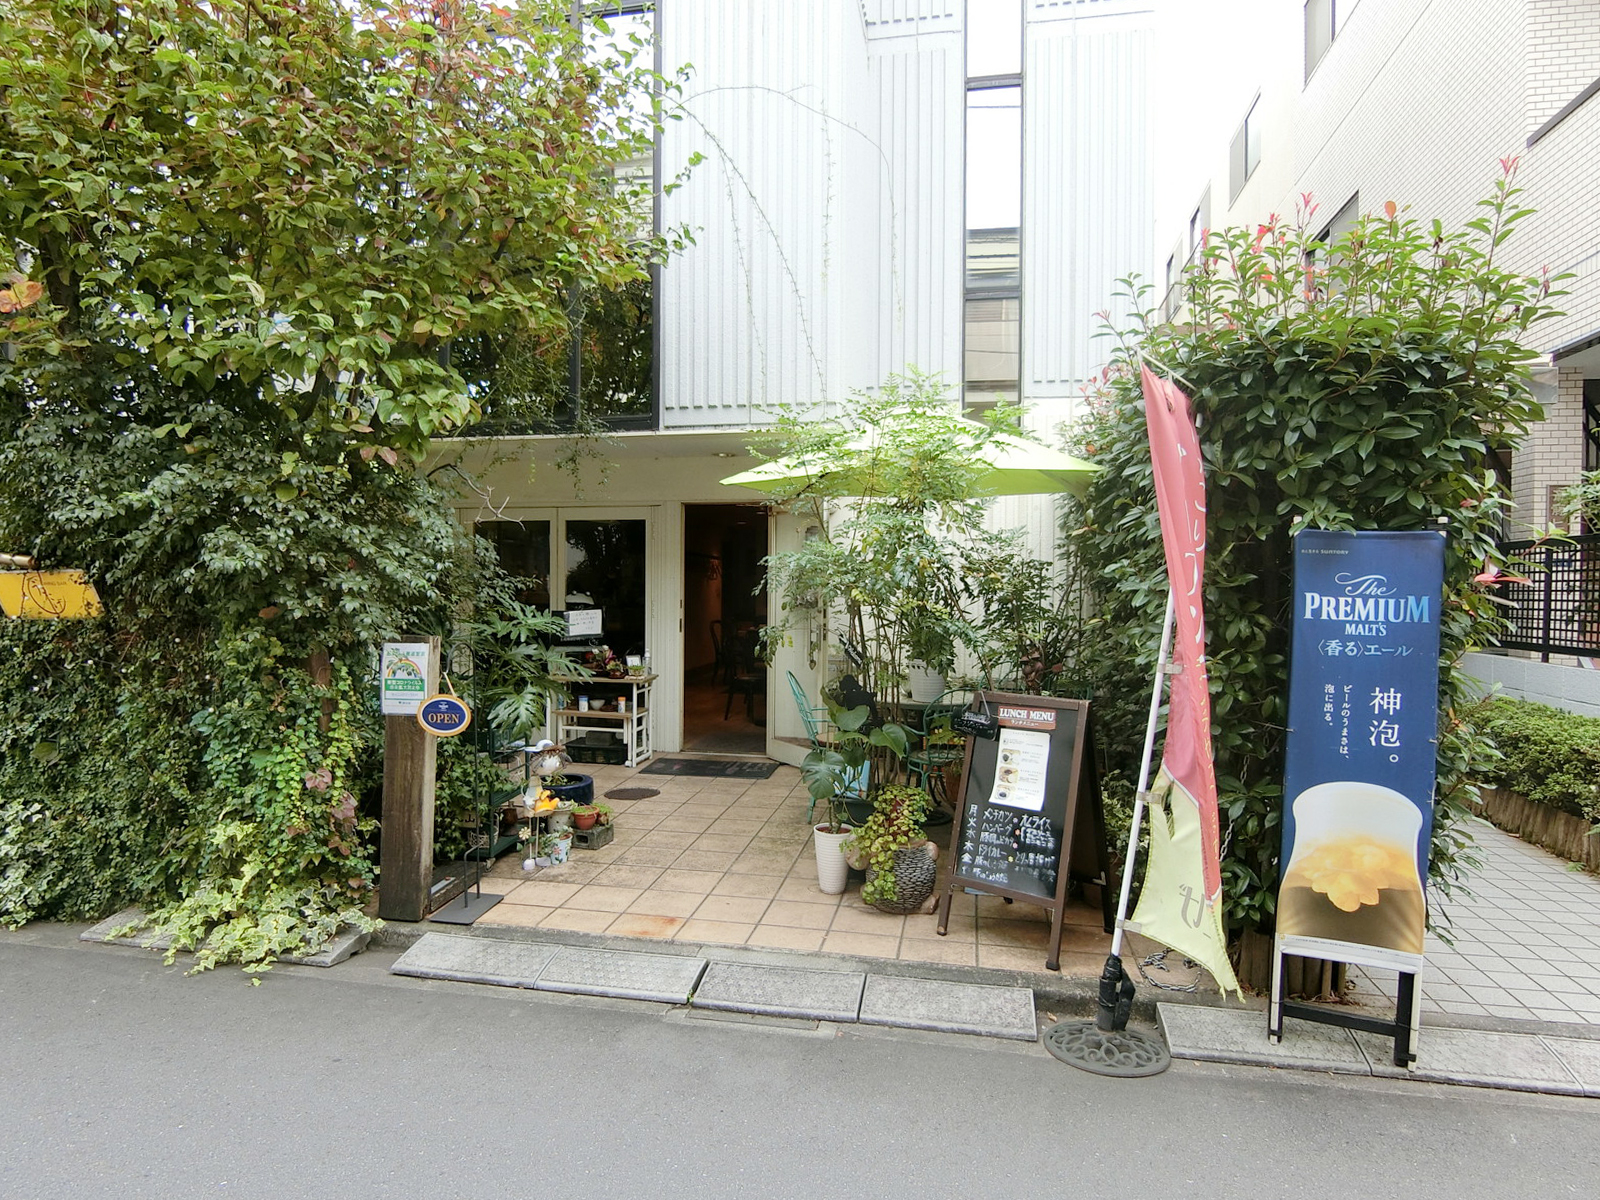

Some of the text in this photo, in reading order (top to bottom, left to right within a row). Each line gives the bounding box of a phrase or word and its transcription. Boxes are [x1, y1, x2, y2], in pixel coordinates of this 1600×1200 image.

[1334, 572, 1397, 596] The
[1303, 592, 1431, 624] PREMIUM
[1345, 622, 1387, 637] MALT'S
[428, 712, 460, 724] OPEN
[999, 708, 1027, 719] LUNCH
[1029, 710, 1055, 721] MENU
[1367, 686, 1402, 763] 神泡。
[968, 804, 978, 816] 月
[967, 817, 977, 827] 火
[963, 840, 974, 851] 木
